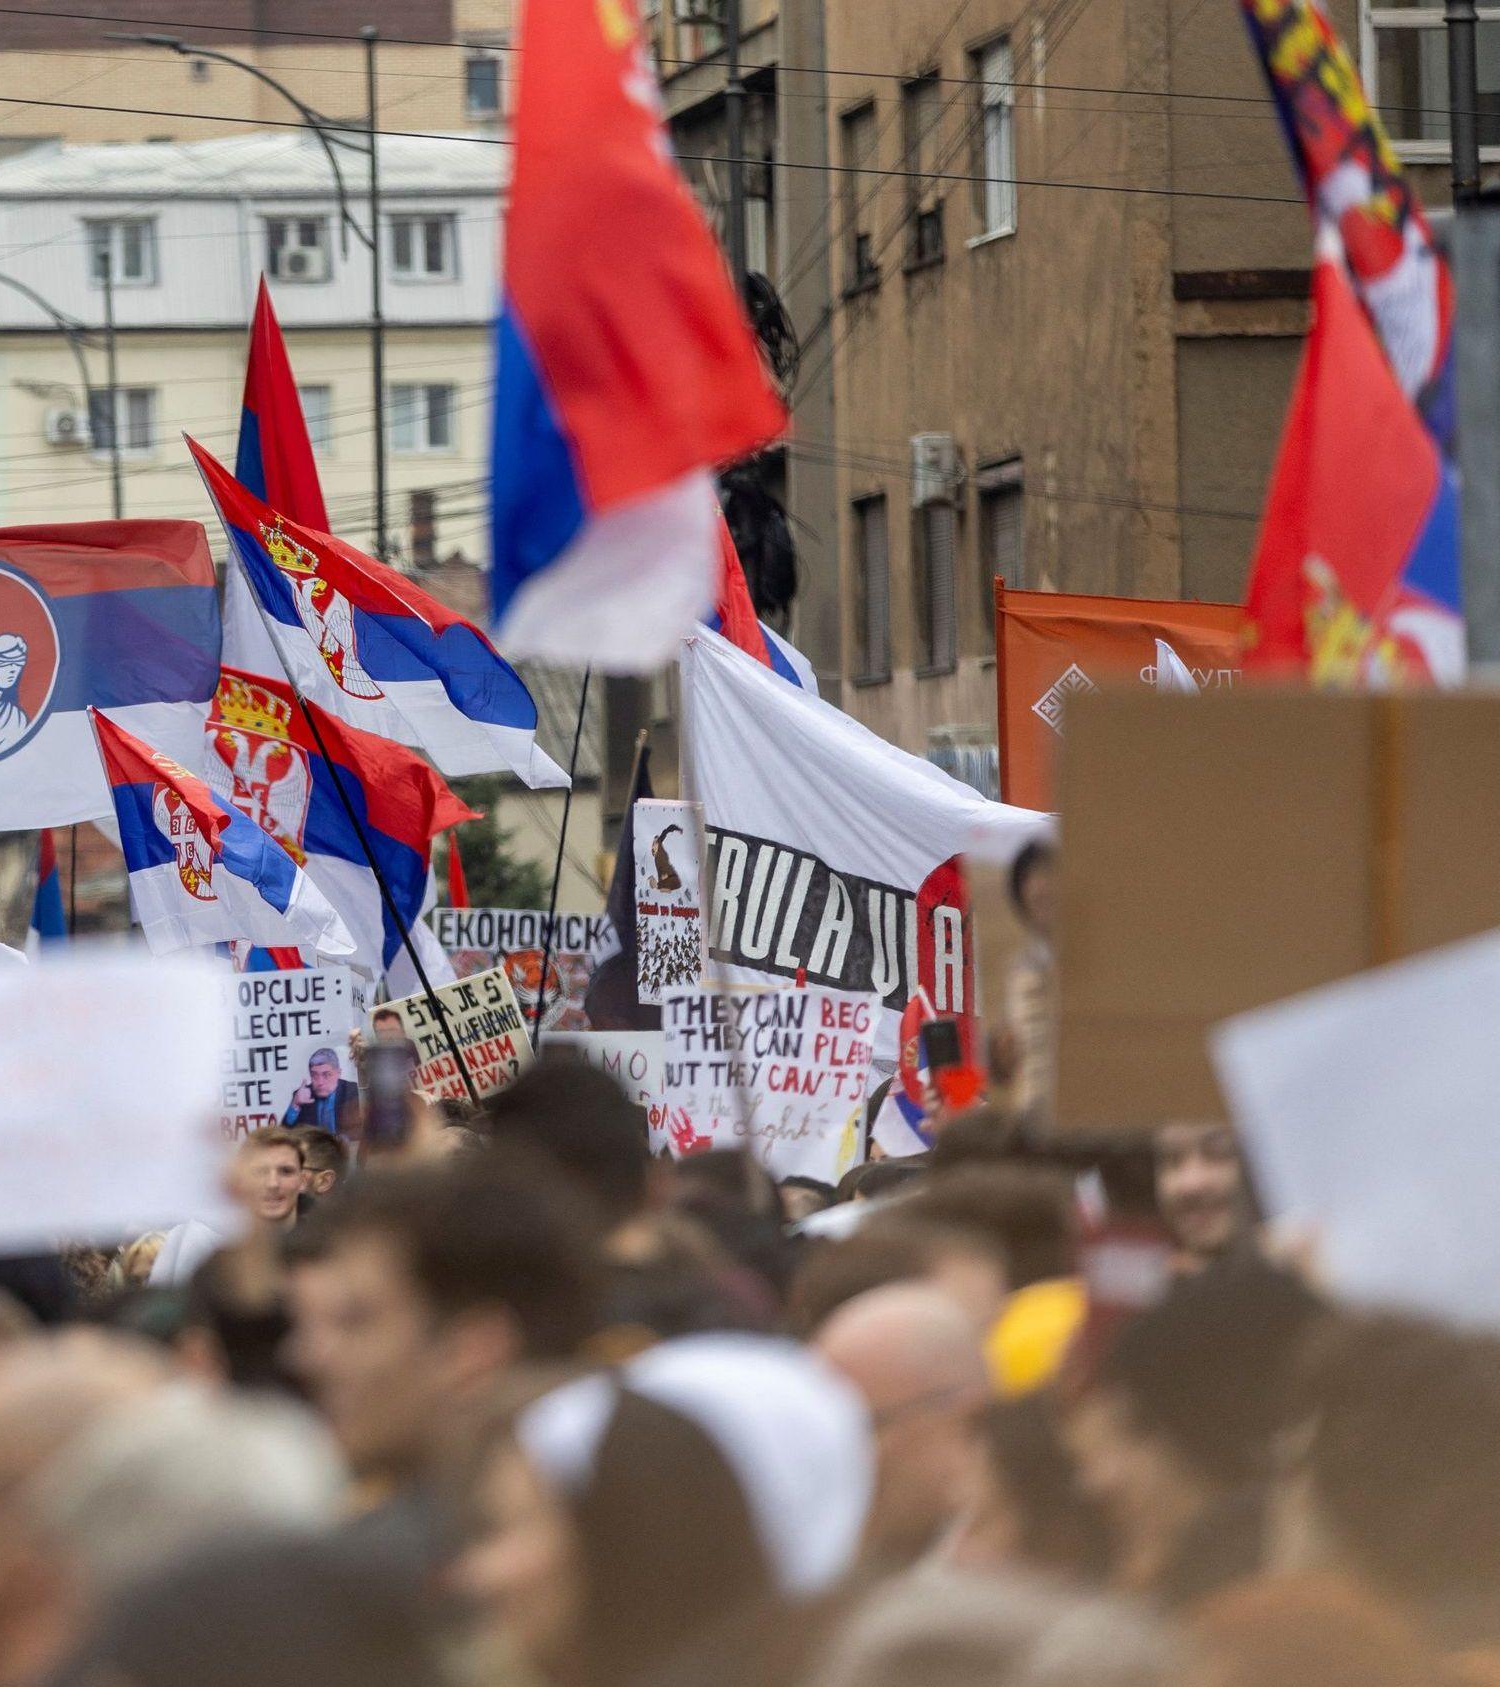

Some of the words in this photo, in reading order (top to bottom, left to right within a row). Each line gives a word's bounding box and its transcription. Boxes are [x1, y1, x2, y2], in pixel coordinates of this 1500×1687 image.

[438, 911, 604, 951] ЕКОНОМСК
[452, 983, 480, 1013] JE
[668, 993, 749, 1026] THEY
[754, 993, 807, 1029] CAN
[821, 997, 870, 1033] BEG
[680, 1025, 752, 1052] THEY
[753, 1028, 803, 1058] CAN
[708, 1062, 762, 1087] THEY
